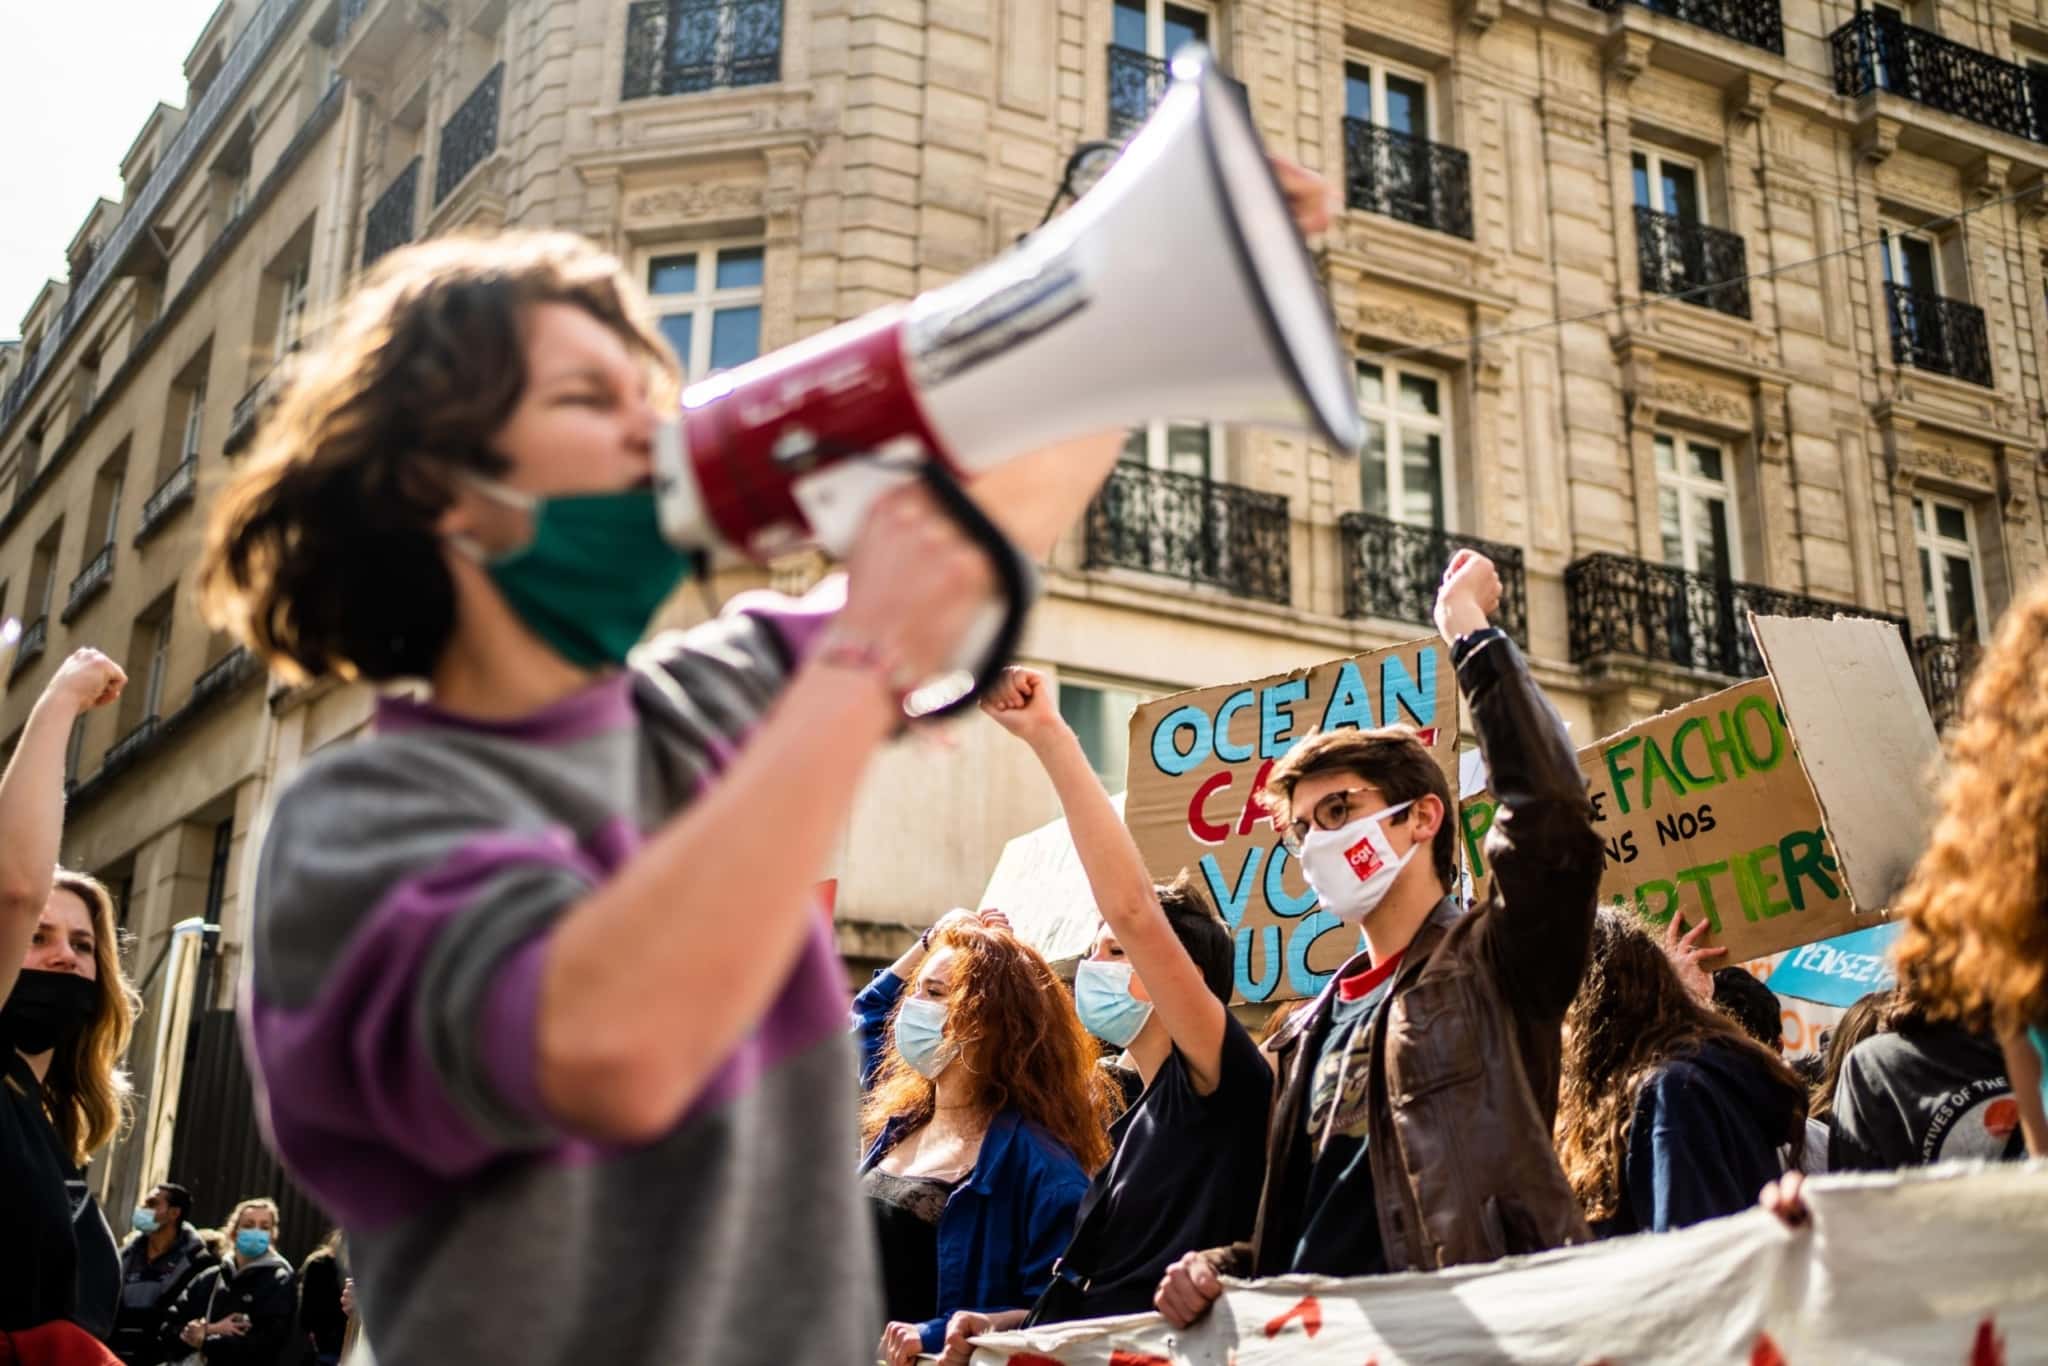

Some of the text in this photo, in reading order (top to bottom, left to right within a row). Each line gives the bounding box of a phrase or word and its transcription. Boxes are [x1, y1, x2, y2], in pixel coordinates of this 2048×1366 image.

[1151, 646, 1438, 776] OCEAN
[1604, 695, 1798, 815] FACHO
[1602, 804, 1716, 870] NS NOS
[1921, 1076, 2008, 1164] ATIVES OF THE
